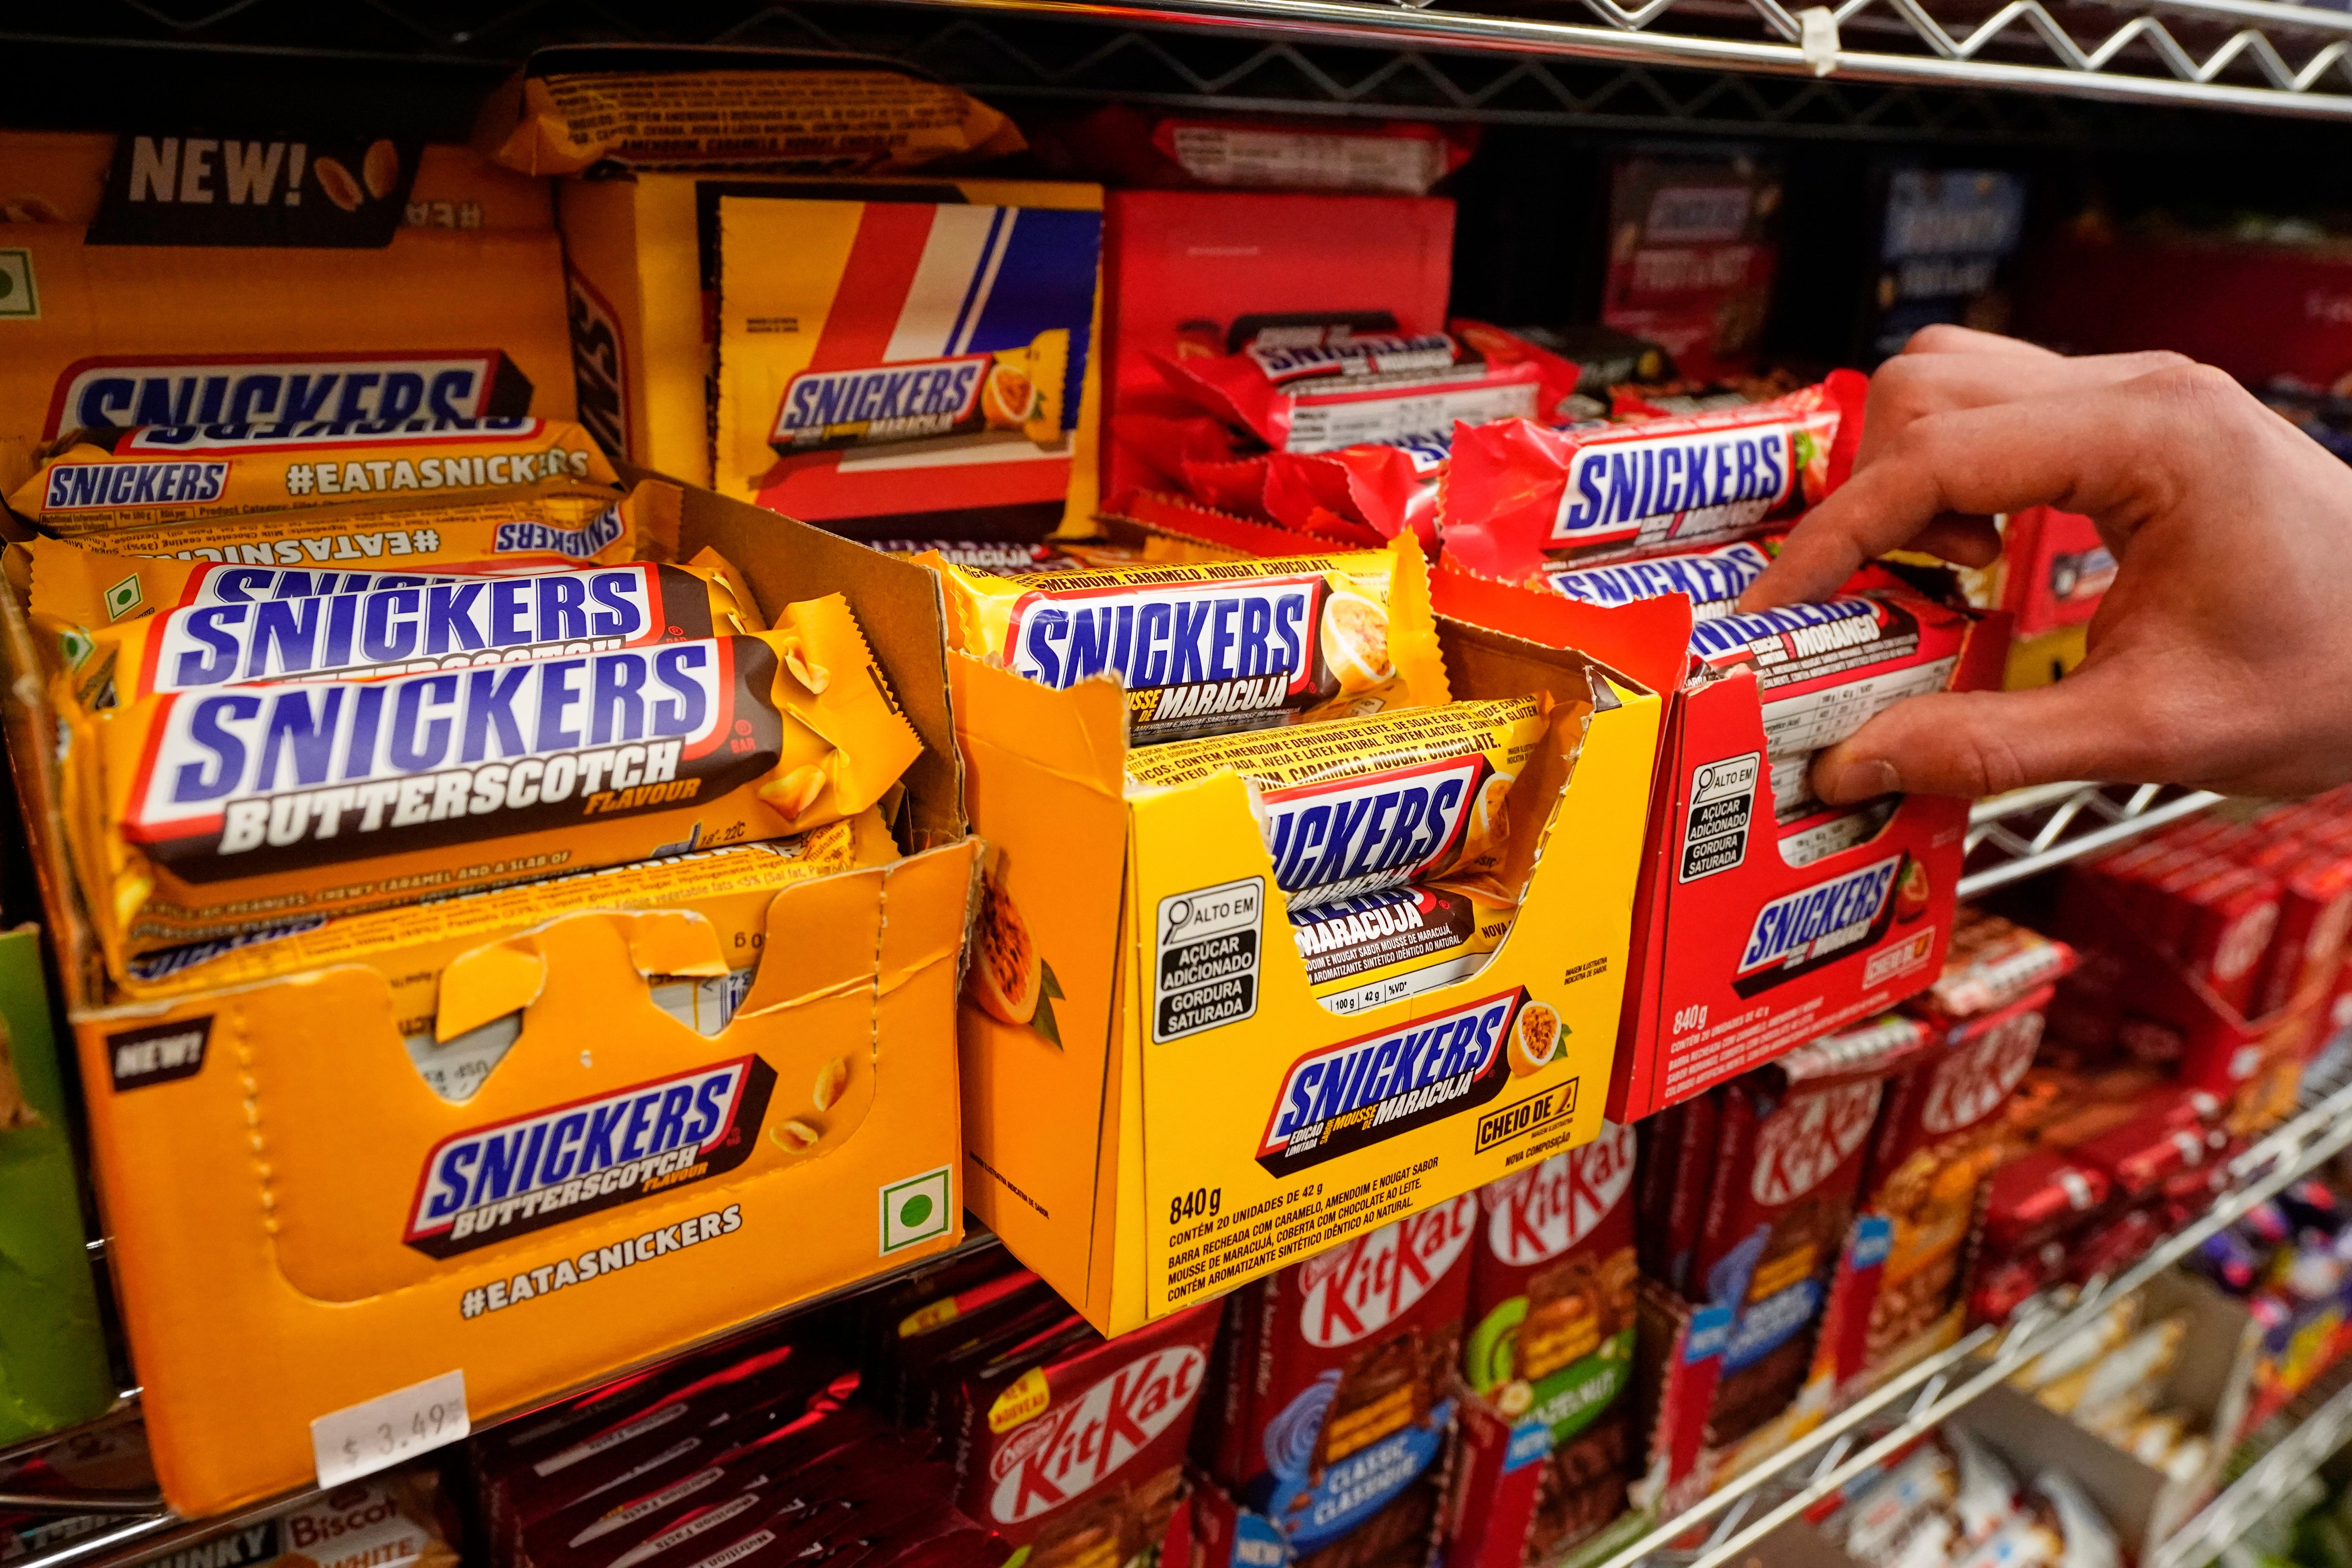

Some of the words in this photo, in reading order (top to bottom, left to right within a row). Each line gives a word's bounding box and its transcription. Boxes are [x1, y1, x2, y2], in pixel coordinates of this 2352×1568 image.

[129, 136, 308, 206] NEW!
[785, 365, 975, 430] SNICKERS
[49, 464, 229, 506] SNICKERS
[1565, 434, 1782, 531] SNICKERS
[495, 504, 625, 559] SNICKERS
[1124, 568, 1207, 584] CARAMELO.
[1208, 564, 1263, 580] NOUGAT.
[1263, 559, 1339, 575] CHOCOLATE.
[170, 572, 641, 688] SNICKERS
[1022, 593, 1304, 692] SNICKERS
[1790, 613, 1881, 658] MORANGO
[1138, 709, 1155, 722] DE
[1152, 671, 1290, 721] MARACUJÁ
[171, 644, 707, 803] SNICKERS
[1174, 753, 1223, 769] CONTÉM
[1224, 742, 1283, 759] AMENDOIM
[1285, 741, 1292, 749] E
[1291, 732, 1349, 748] DERIVADOS
[1350, 729, 1362, 738] DE
[1363, 724, 1395, 734] LEITE,
[1393, 720, 1407, 730] DE
[1408, 717, 1435, 728] SOJA
[1439, 714, 1452, 722] DE
[1262, 755, 1294, 768] AVEIA
[1293, 752, 1303, 761] E
[1305, 745, 1336, 759] LÁTEX
[1335, 738, 1385, 753] NATURAL.
[1385, 728, 1425, 744] CONTÉM
[1468, 717, 1506, 730] CONTÉM
[1506, 705, 1538, 721] GLÚTEN
[1289, 756, 1371, 784] CARAMELO.
[1369, 742, 1427, 771] NOUGAT.
[1425, 732, 1502, 760] CHOCOLATE.
[1714, 773, 1737, 790] ALTO
[1739, 767, 1753, 782] EM
[218, 740, 682, 855] BUTTERSCOTCH
[583, 777, 702, 816] FLAVOUR
[1701, 801, 1740, 823] AÇÚCAR
[1690, 813, 1747, 841] ADICIONADO
[1693, 835, 1738, 859] GORDURA
[379, 869, 452, 892] CARAMEL
[457, 865, 490, 879] AND
[494, 862, 505, 874] A
[510, 855, 547, 871] SLAB
[551, 850, 572, 864] OF
[1688, 850, 1737, 875] SATURADA
[1195, 904, 1231, 926] ALTO
[1233, 898, 1254, 915] EM
[1295, 900, 1424, 957] MARACUJÁ
[1482, 923, 1507, 938] NOVA
[1745, 863, 1895, 966] SNICKERS
[1163, 951, 1253, 992] ADICIONADO
[1179, 936, 1240, 968] AÇÚCAR
[1314, 962, 1363, 983] AROMATIZANTE
[1363, 953, 1396, 970] SINTÉTICO
[1396, 946, 1424, 961] IDÊNTICO
[1424, 944, 1434, 954] AO
[1434, 935, 1463, 951] NATURAL.
[1332, 949, 1358, 964] NOUGAT
[1359, 944, 1380, 959] SABOR
[1380, 938, 1407, 952] MOUSSE
[1408, 934, 1418, 944] DE
[1565, 963, 1583, 977] IMAGEM
[1583, 956, 1608, 971] ILUSTRATIVA
[1171, 981, 1242, 1013] GORDURA
[1335, 1000, 1348, 1010] 100
[1349, 999, 1354, 1009] g
[1365, 992, 1373, 1002] 42
[1374, 992, 1380, 1001] g
[1564, 972, 1586, 985] INDICATIVA
[1586, 970, 1593, 978] DE
[1168, 997, 1244, 1033] SATURADA
[114, 1031, 204, 1079] NEW!
[1277, 1004, 1506, 1139] SNICKERS
[1288, 1121, 1322, 1147] EDIÇÃO
[1320, 1118, 1333, 1146] SABOR
[1333, 1104, 1379, 1133] MOUSSE
[1374, 1069, 1475, 1126] MARACUJÁ
[1481, 1107, 1528, 1145] CHEIO
[1532, 1095, 1554, 1121] DE
[425, 1072, 734, 1219] SNICKERS
[1285, 1139, 1318, 1158] LIMITADA
[1362, 1118, 1372, 1132] DE
[1505, 1150, 1524, 1167] NOVA
[1526, 1132, 1571, 1160] COMPOSIÇÃO
[449, 1144, 701, 1241] BUTTERSCOTCH
[642, 1162, 708, 1193] FLAVOUR
[1168, 1247, 1200, 1270] BARRA
[1202, 1232, 1250, 1255] RECHEADA
[1251, 1220, 1273, 1237] COM
[1274, 1204, 1324, 1227] CARAMELO,
[1325, 1186, 1371, 1210] AMENDOIM
[1372, 1180, 1378, 1192] E
[1379, 1167, 1411, 1189] NOUGAT
[1412, 1156, 1439, 1176] SABOR
[1169, 1222, 1213, 1248] CONTÉM
[1216, 1215, 1230, 1231] 20
[1232, 1196, 1283, 1226] UNIDADES
[1286, 1192, 1300, 1205] DE
[1301, 1186, 1315, 1200] 42
[1315, 1183, 1323, 1195] g
[1509, 1125, 1635, 1259] KitKat
[1168, 1266, 1207, 1286] MOUSSE
[1208, 1256, 1221, 1270] DE
[1223, 1233, 1275, 1265] MARACUJÁ,
[1275, 1223, 1315, 1247] COBERTA
[1317, 1213, 1336, 1228] COM
[1338, 1194, 1385, 1219] CHOCOLATE
[1385, 1188, 1397, 1201] AO
[1398, 1177, 1422, 1195] LEITE.
[1168, 1276, 1206, 1301] CONTÉM
[1208, 1251, 1276, 1288] AROMATIZANTE
[1278, 1231, 1322, 1259] SINTÉTICO
[1324, 1216, 1362, 1243] IDÊNTICO
[1363, 1211, 1375, 1225] AO
[1376, 1197, 1414, 1219] NATURAL.
[460, 1204, 743, 1320] #EATASNICKERS
[1320, 1189, 1477, 1342] KitKat
[377, 1403, 444, 1455] 3.49
[1013, 1351, 1200, 1518] KitKat
